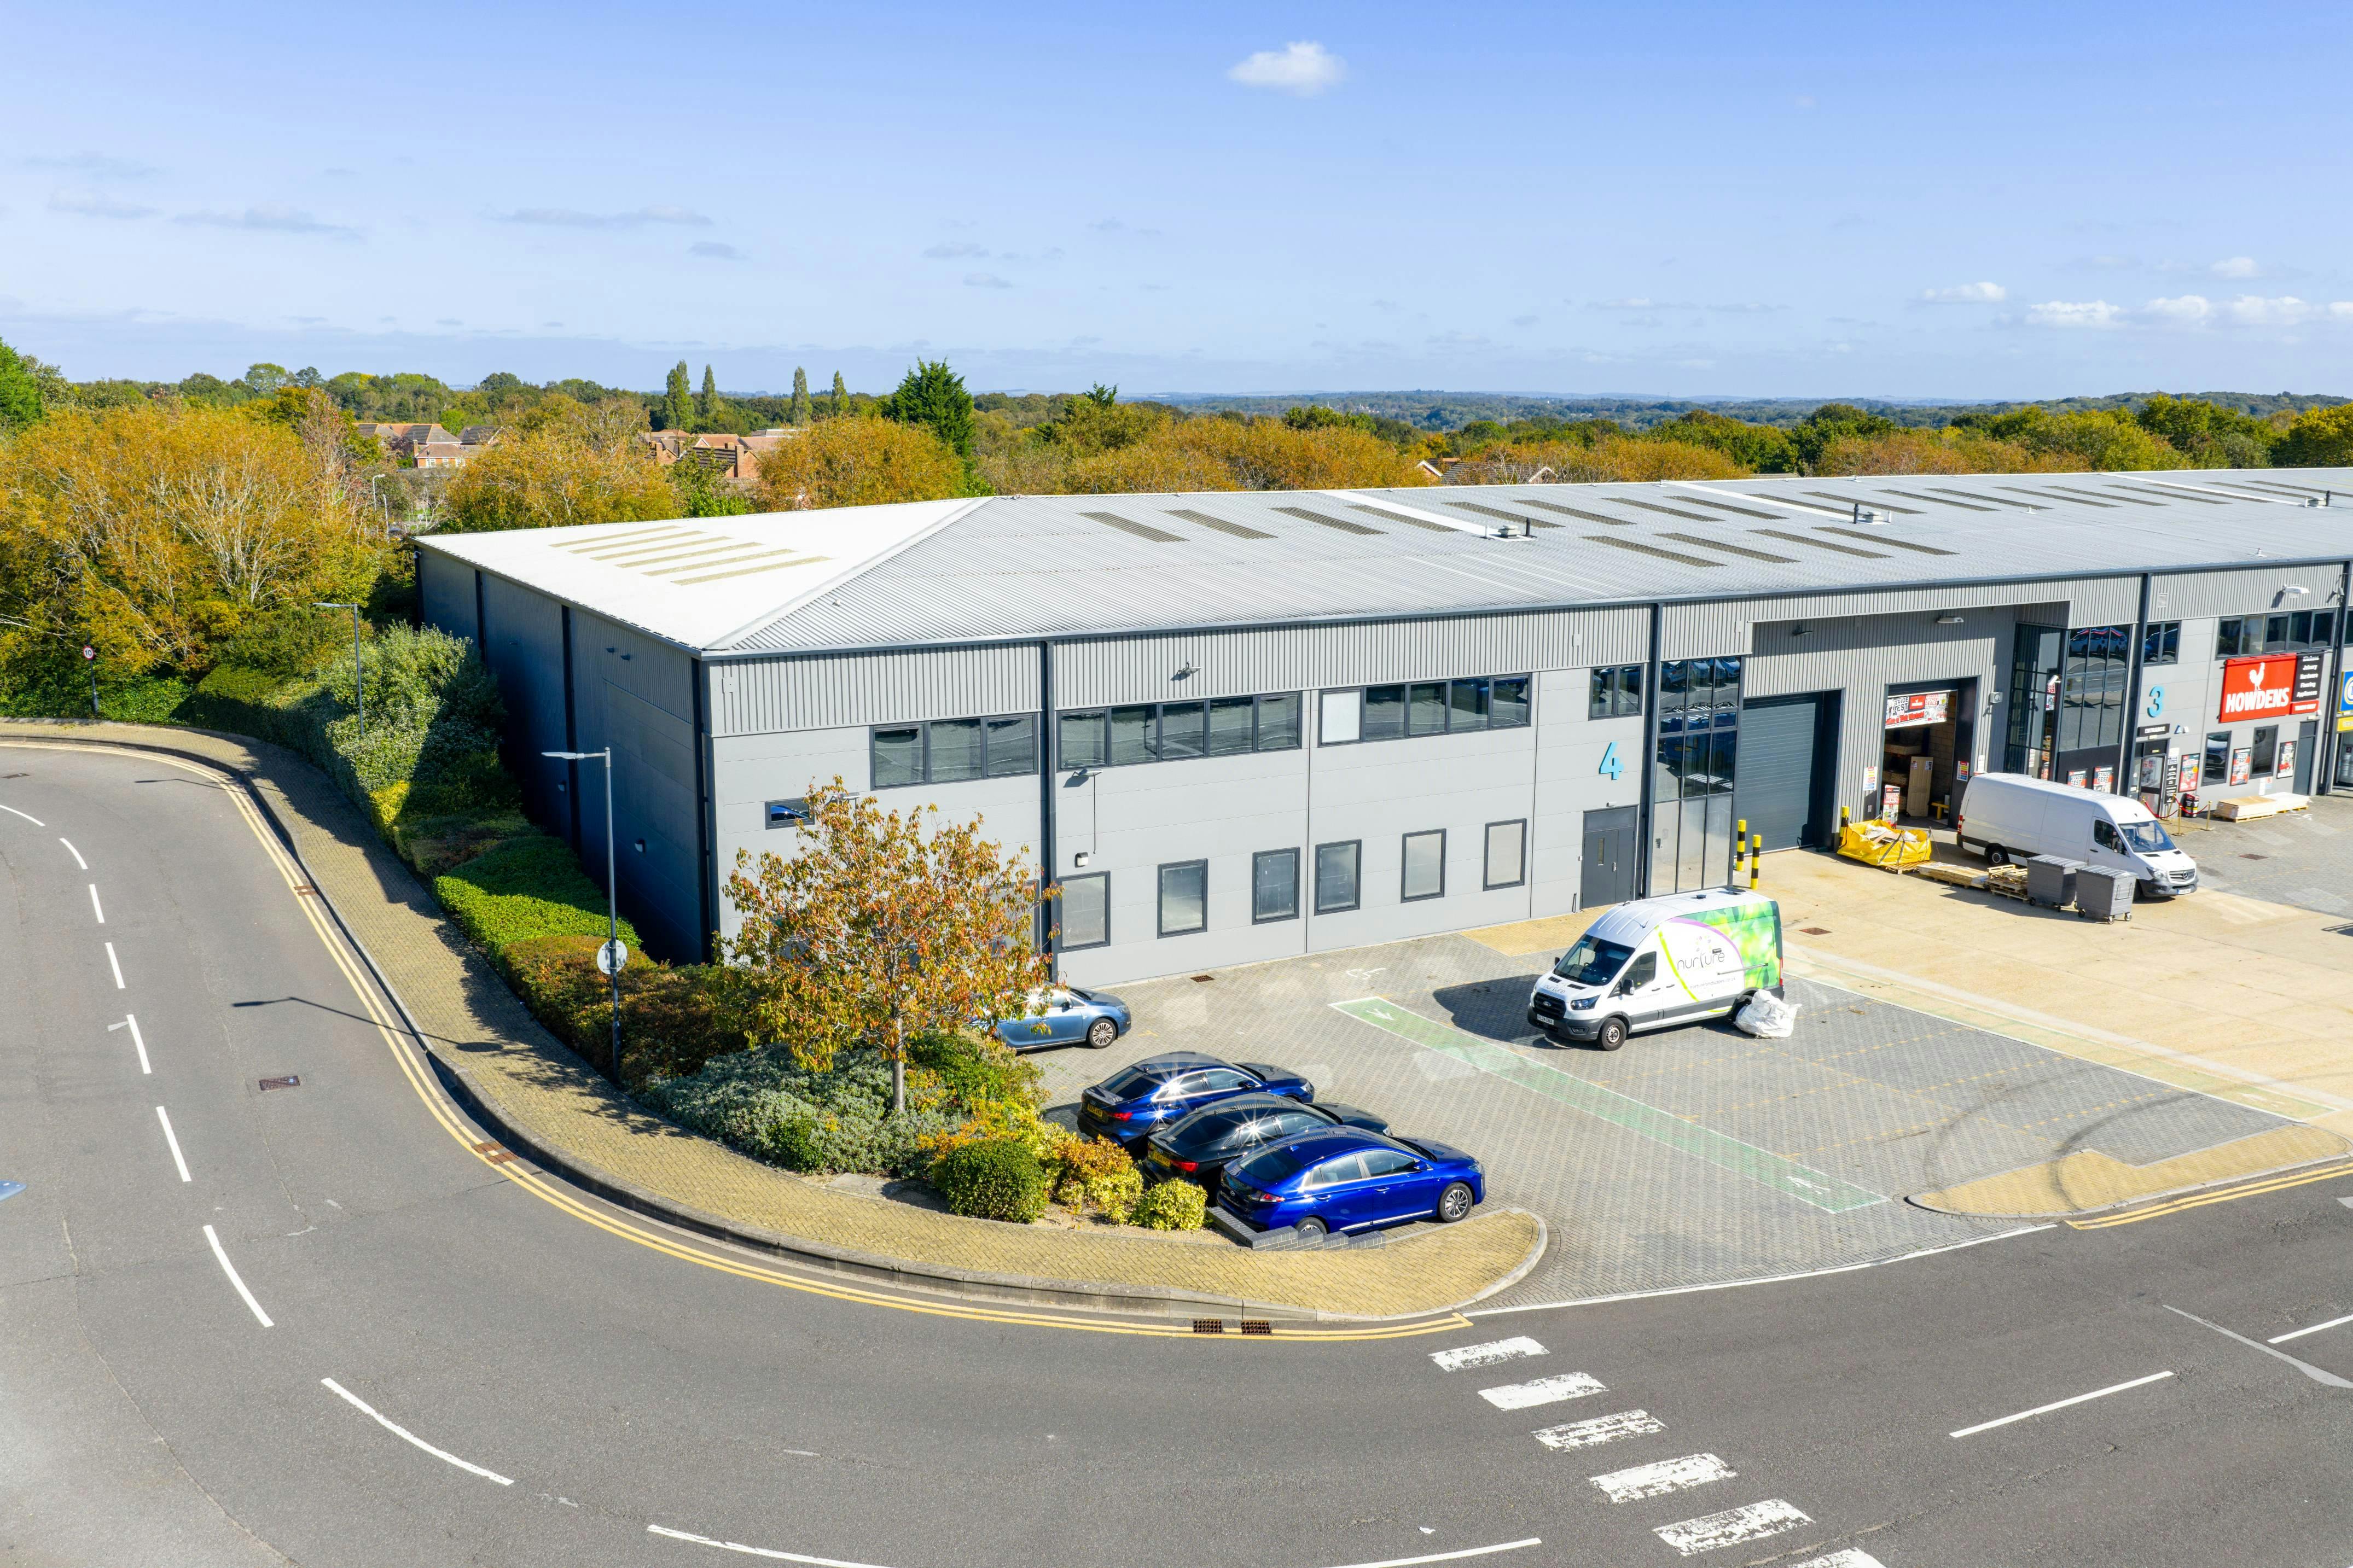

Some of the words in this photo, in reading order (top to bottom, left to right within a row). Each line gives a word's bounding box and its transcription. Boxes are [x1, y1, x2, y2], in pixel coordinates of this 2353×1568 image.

[2147, 685, 2165, 718] 3
[2226, 687, 2290, 713] HOWDENS
[1599, 741, 1624, 780] 4
[1677, 952, 1725, 970] nurture
[1544, 984, 1565, 994] nurture
